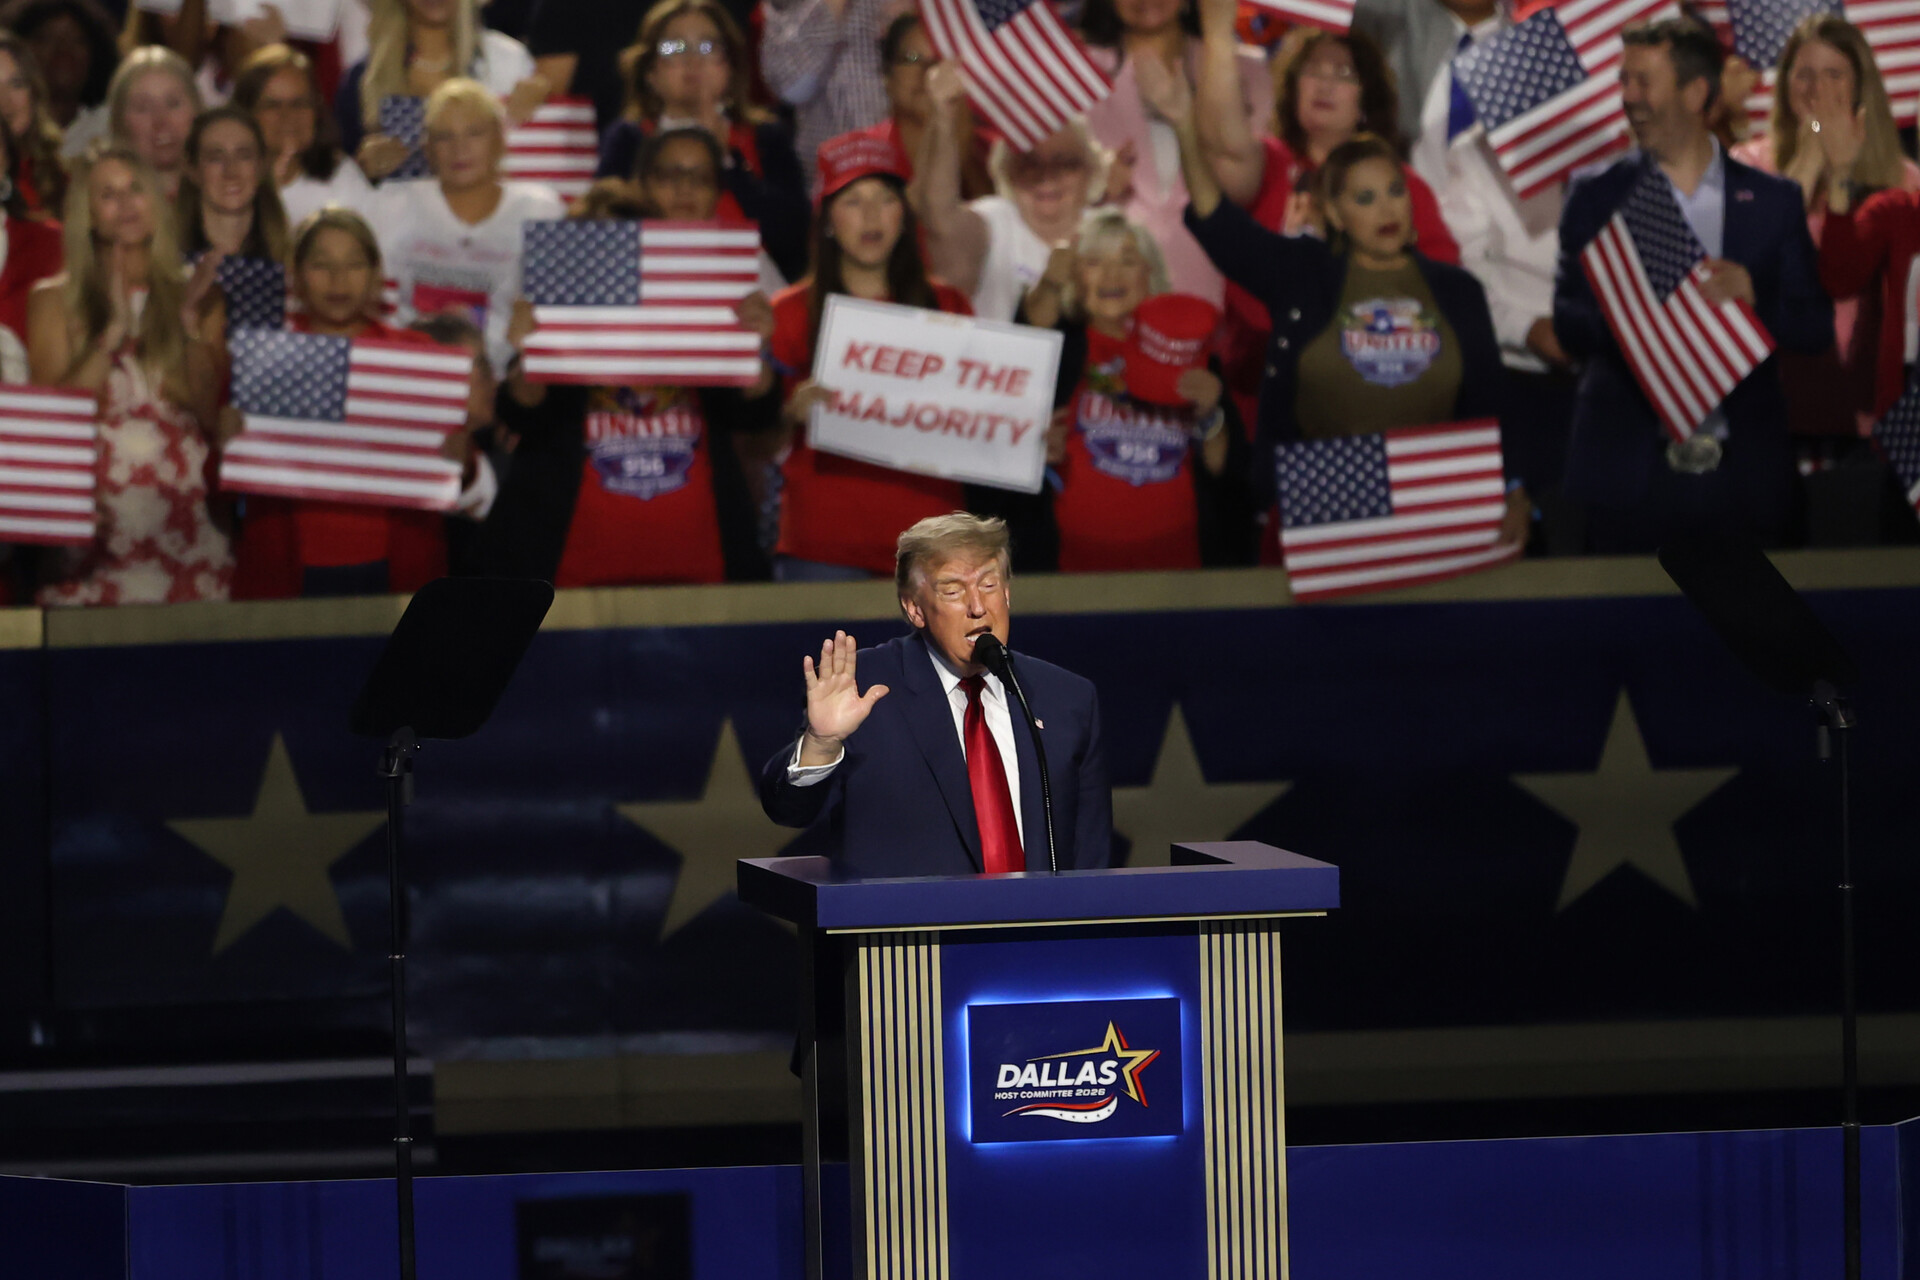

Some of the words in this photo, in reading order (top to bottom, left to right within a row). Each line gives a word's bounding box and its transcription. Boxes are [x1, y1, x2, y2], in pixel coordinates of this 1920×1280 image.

[841, 340, 946, 381] KEEP
[956, 358, 1033, 397] THE
[823, 388, 1035, 446] MAJORITY
[994, 1091, 1019, 1100] HOST
[1020, 1089, 1073, 1099] COMMITTEE
[1074, 1088, 1106, 1096] 2026
[996, 1060, 1119, 1089] DALLAS
